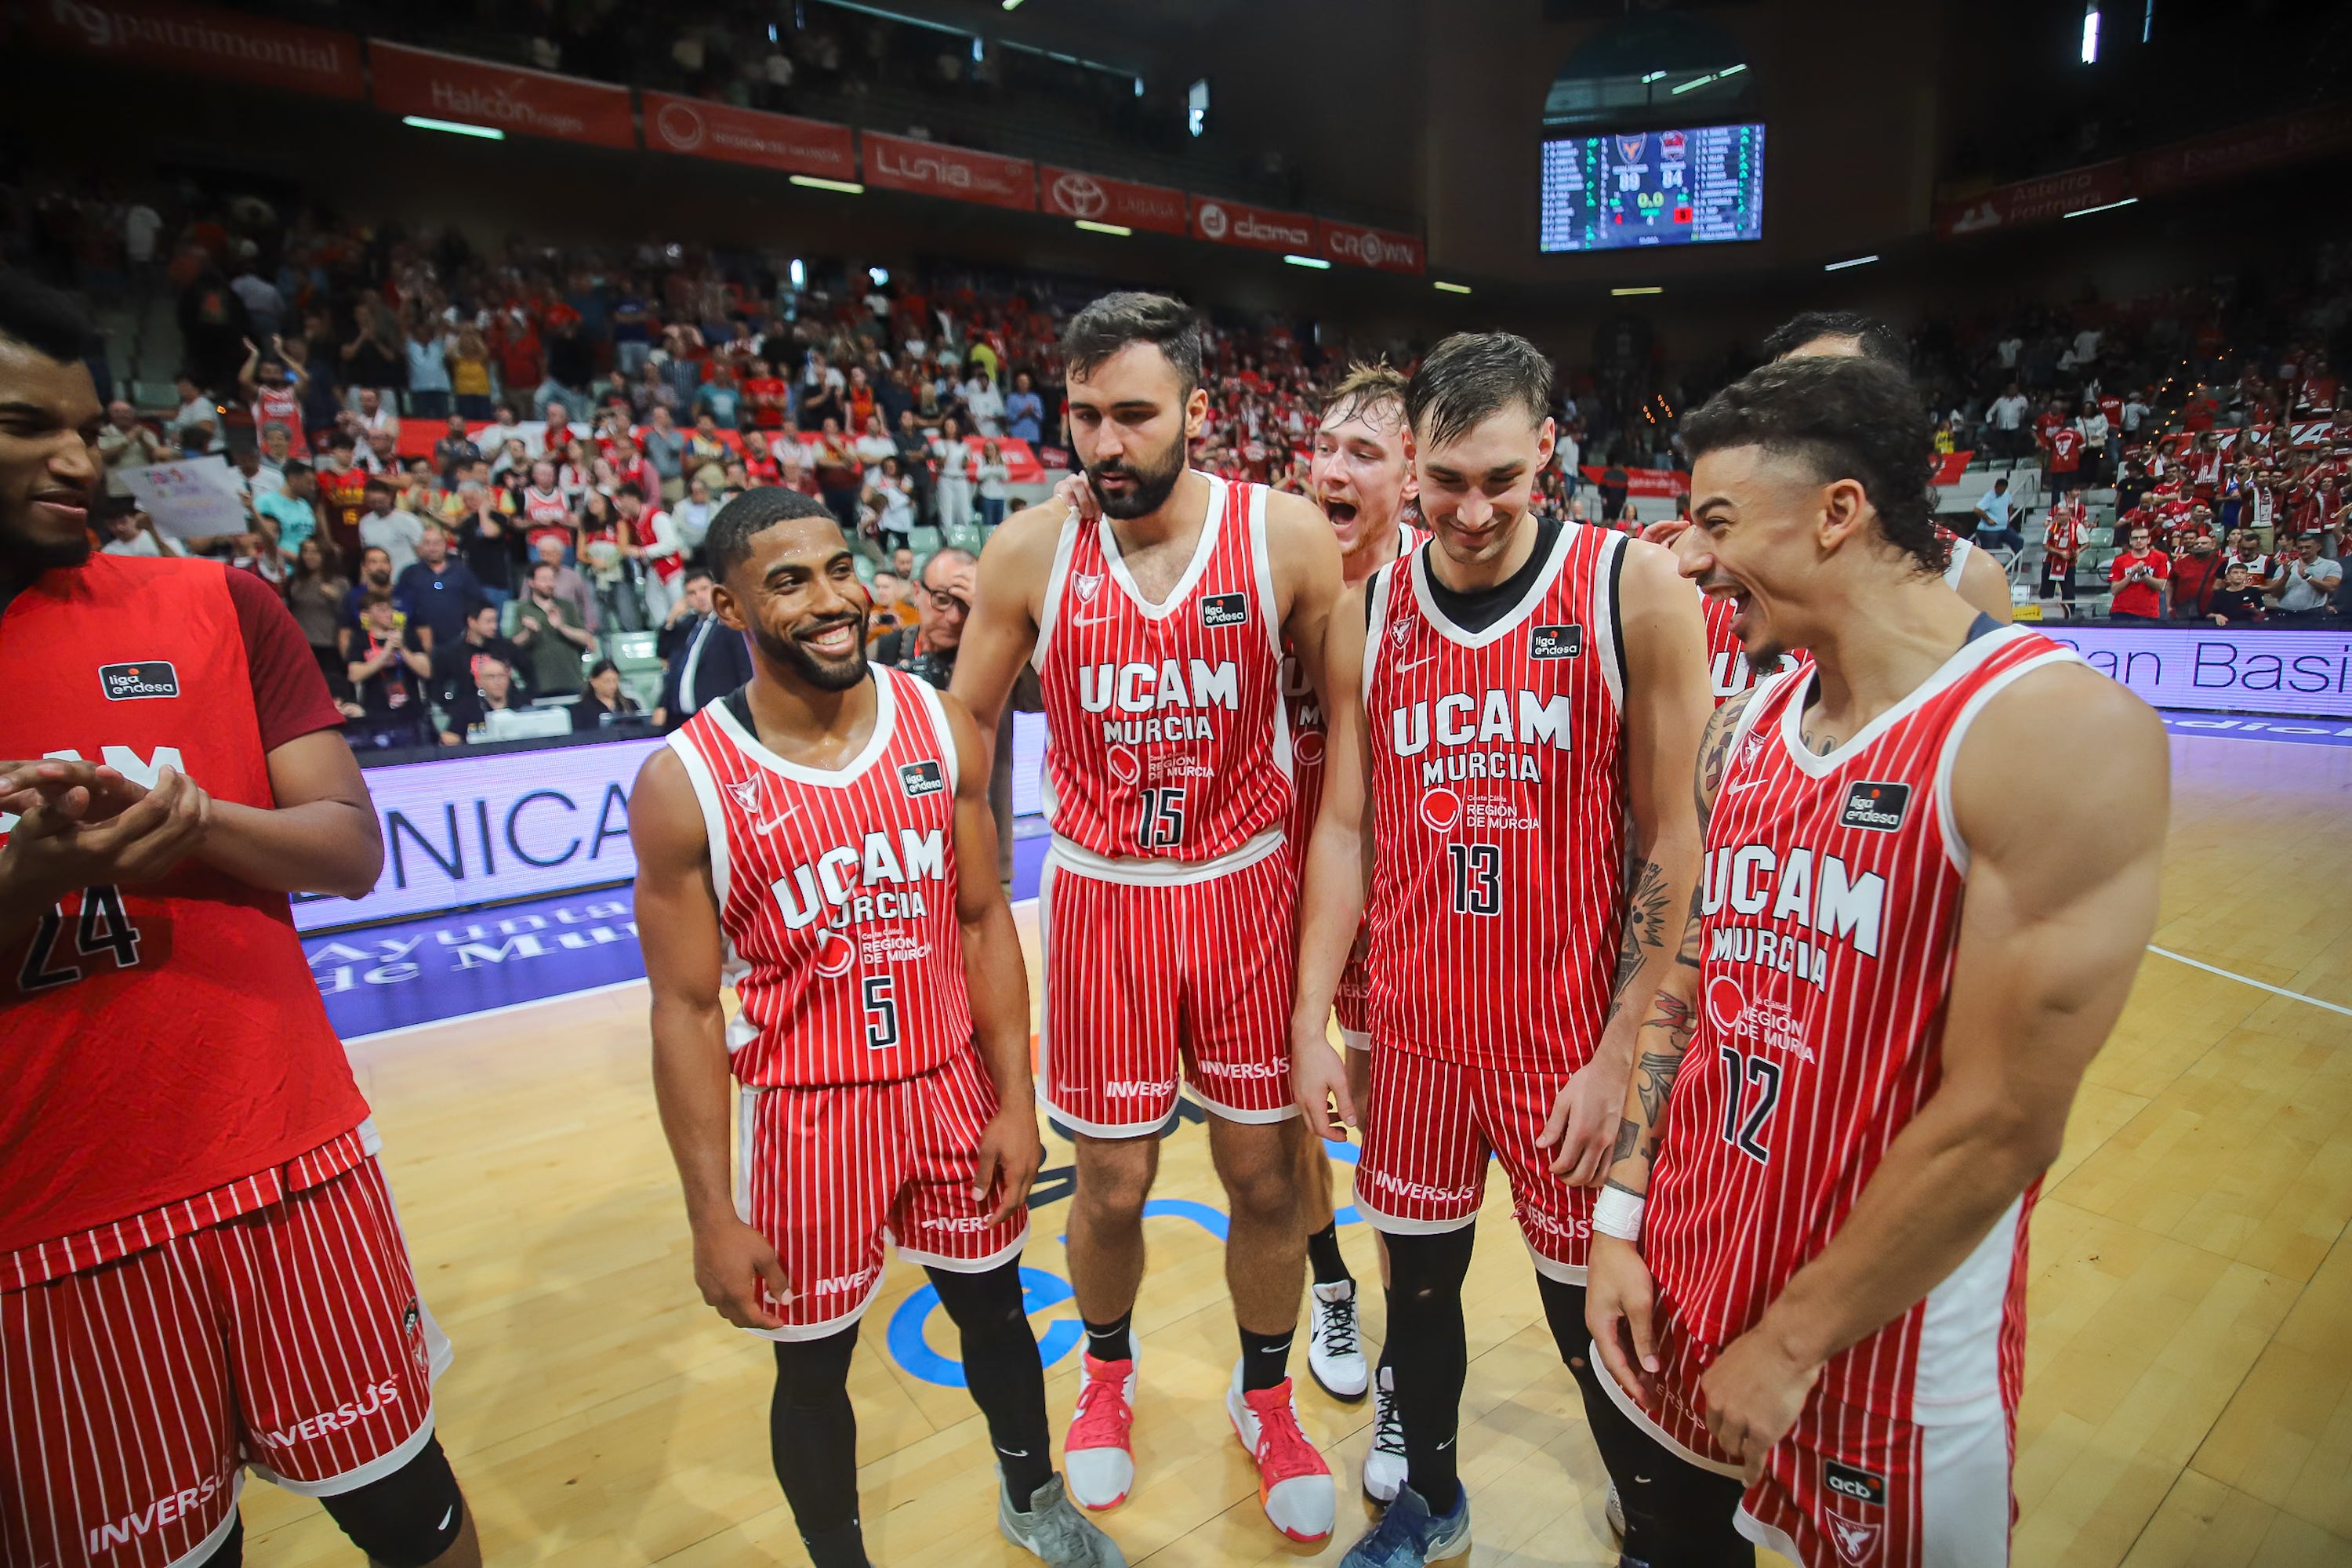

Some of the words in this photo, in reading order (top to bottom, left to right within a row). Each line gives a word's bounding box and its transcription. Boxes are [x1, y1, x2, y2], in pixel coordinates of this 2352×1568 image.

[1535, 637, 1555, 648] liga
[1535, 642, 1577, 655] endesa
[2054, 639, 2161, 685] an
[109, 673, 140, 687] liga
[112, 681, 174, 695] endesa
[1079, 659, 1239, 713] UCAM
[1102, 716, 1214, 745] MURCIA
[1392, 689, 1573, 758] UCAM
[1167, 767, 1214, 778] MURCIA
[1422, 751, 1541, 788] MURCIA
[1466, 803, 1517, 817] REGIÓN
[1846, 807, 1899, 825] endesa
[1849, 794, 1875, 811] liga
[1138, 787, 1187, 849] 15
[1466, 815, 1485, 828] DE
[1489, 818, 1540, 829] MURCIA
[770, 828, 944, 931] UCAM
[1448, 843, 1501, 916] 13
[830, 891, 928, 930] URCIA
[1700, 844, 1886, 959] UCAM
[862, 935, 916, 953] REGIÓN
[864, 953, 884, 964] DE
[887, 942, 932, 962] MURCIA
[1709, 927, 1828, 993] MURCIA
[862, 975, 898, 1051] 5
[1737, 1020, 1759, 1040] DE
[1200, 1057, 1291, 1080] INVERSUS
[1719, 1044, 1782, 1167] 12
[1375, 1170, 1476, 1201] INVERSUS
[1829, 1475, 1871, 1499] acb
[89, 1458, 227, 1555] INVERSU
